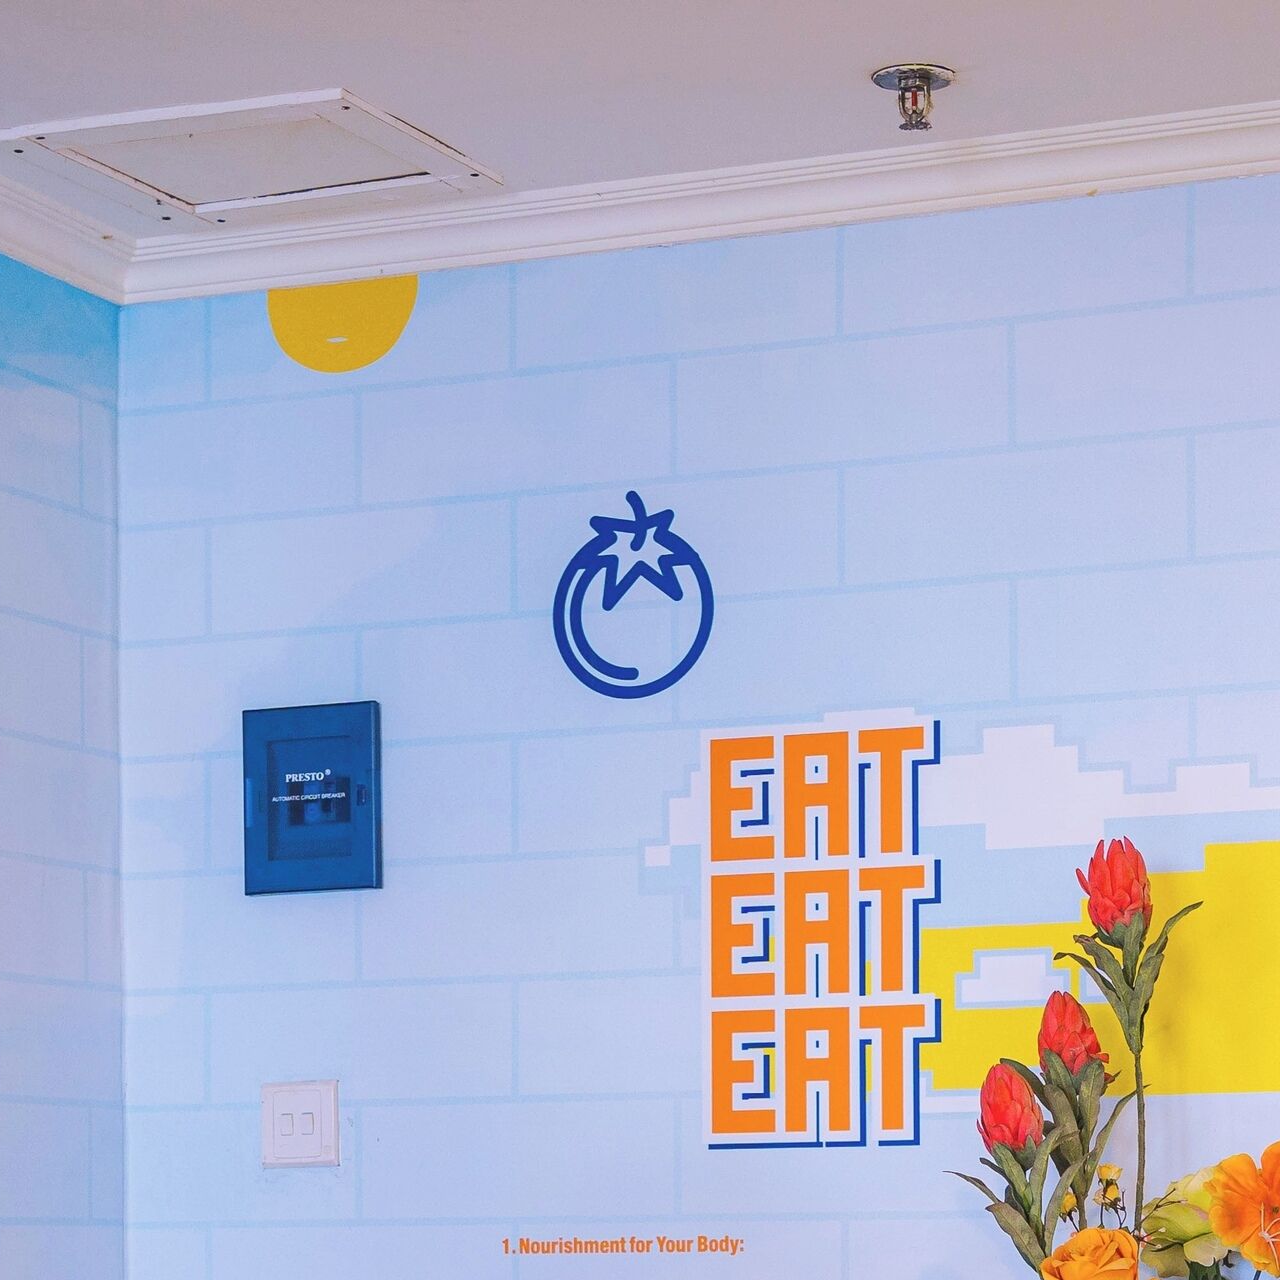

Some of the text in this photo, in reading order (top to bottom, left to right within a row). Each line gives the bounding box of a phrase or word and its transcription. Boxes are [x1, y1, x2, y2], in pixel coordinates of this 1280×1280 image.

[709, 724, 932, 862] EAT
[710, 862, 933, 998] EAT
[710, 1002, 933, 1142] EAT
[502, 1235, 745, 1256] 1. Nourishment for Your Body:
